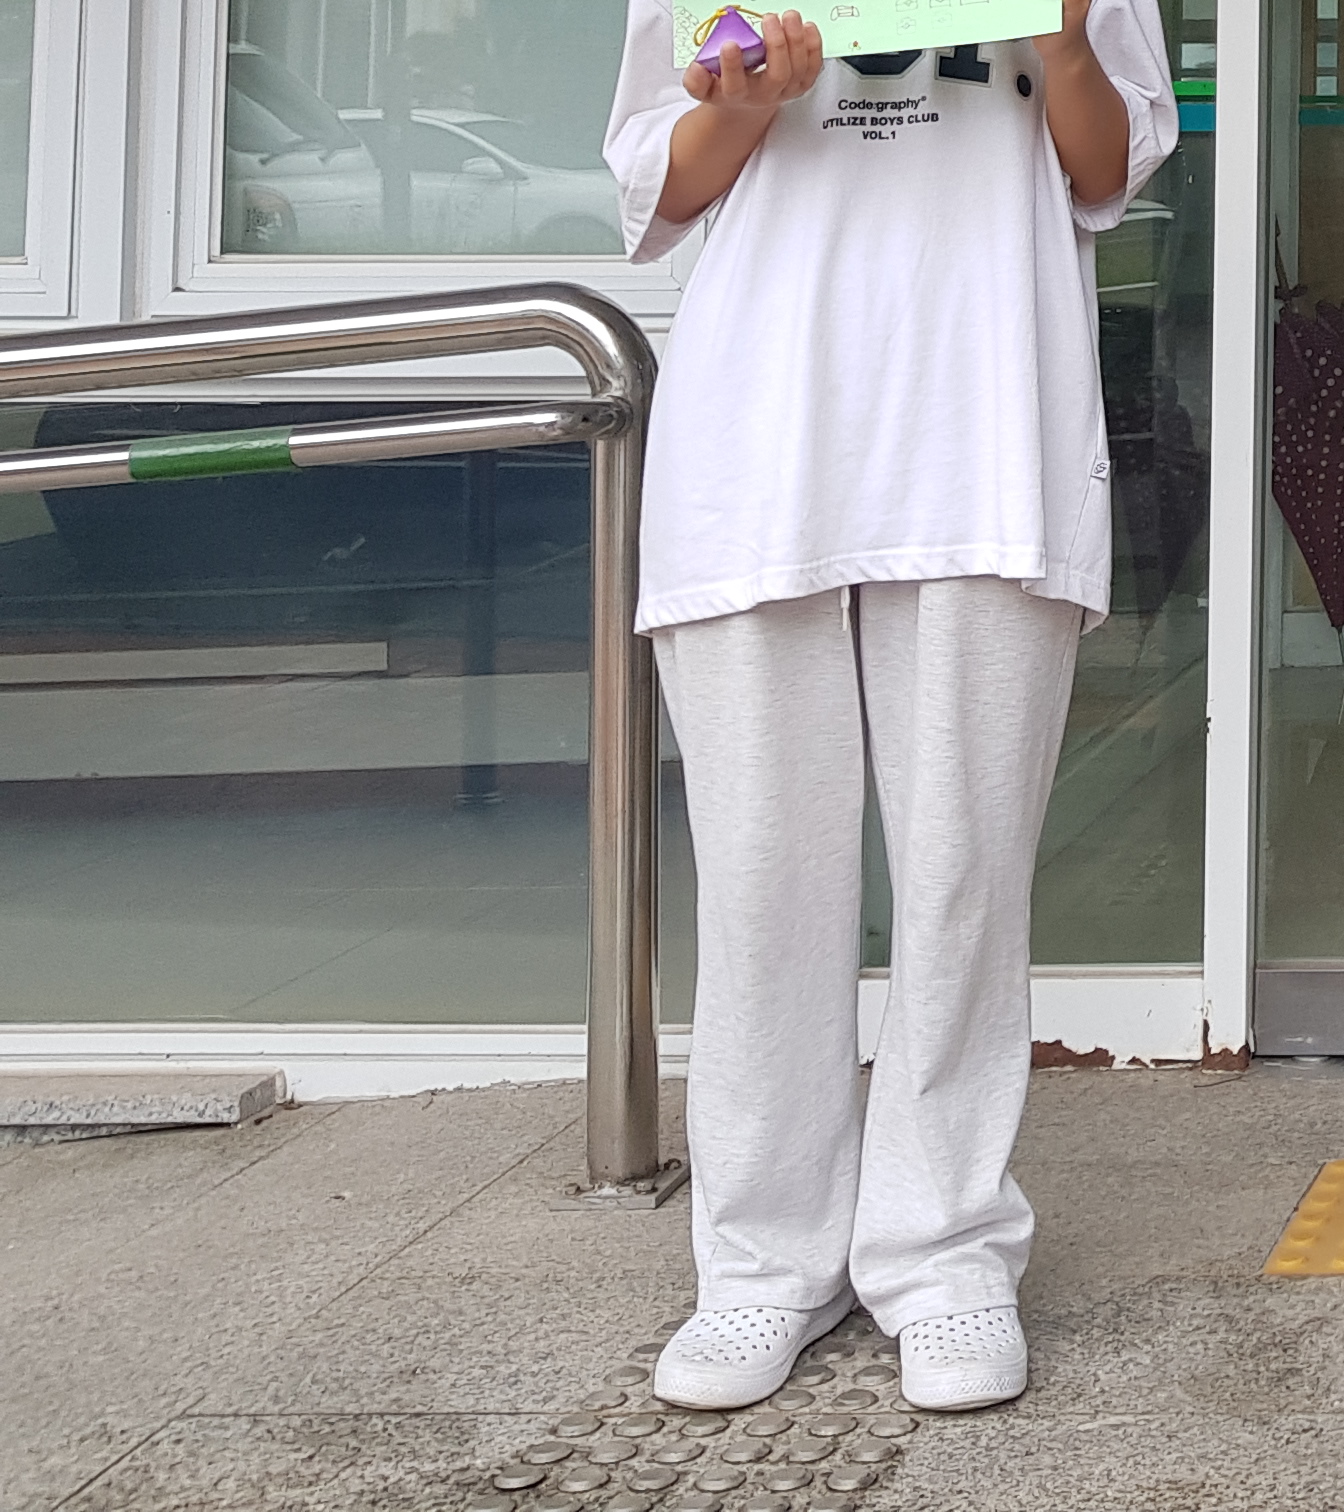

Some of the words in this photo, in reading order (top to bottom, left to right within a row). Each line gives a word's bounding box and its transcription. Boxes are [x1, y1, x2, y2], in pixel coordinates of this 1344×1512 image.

[822, 115, 867, 130] UTILIZE
[869, 114, 904, 127] BOYS
[907, 112, 940, 124] CLUB
[861, 130, 896, 140] VOL.1
